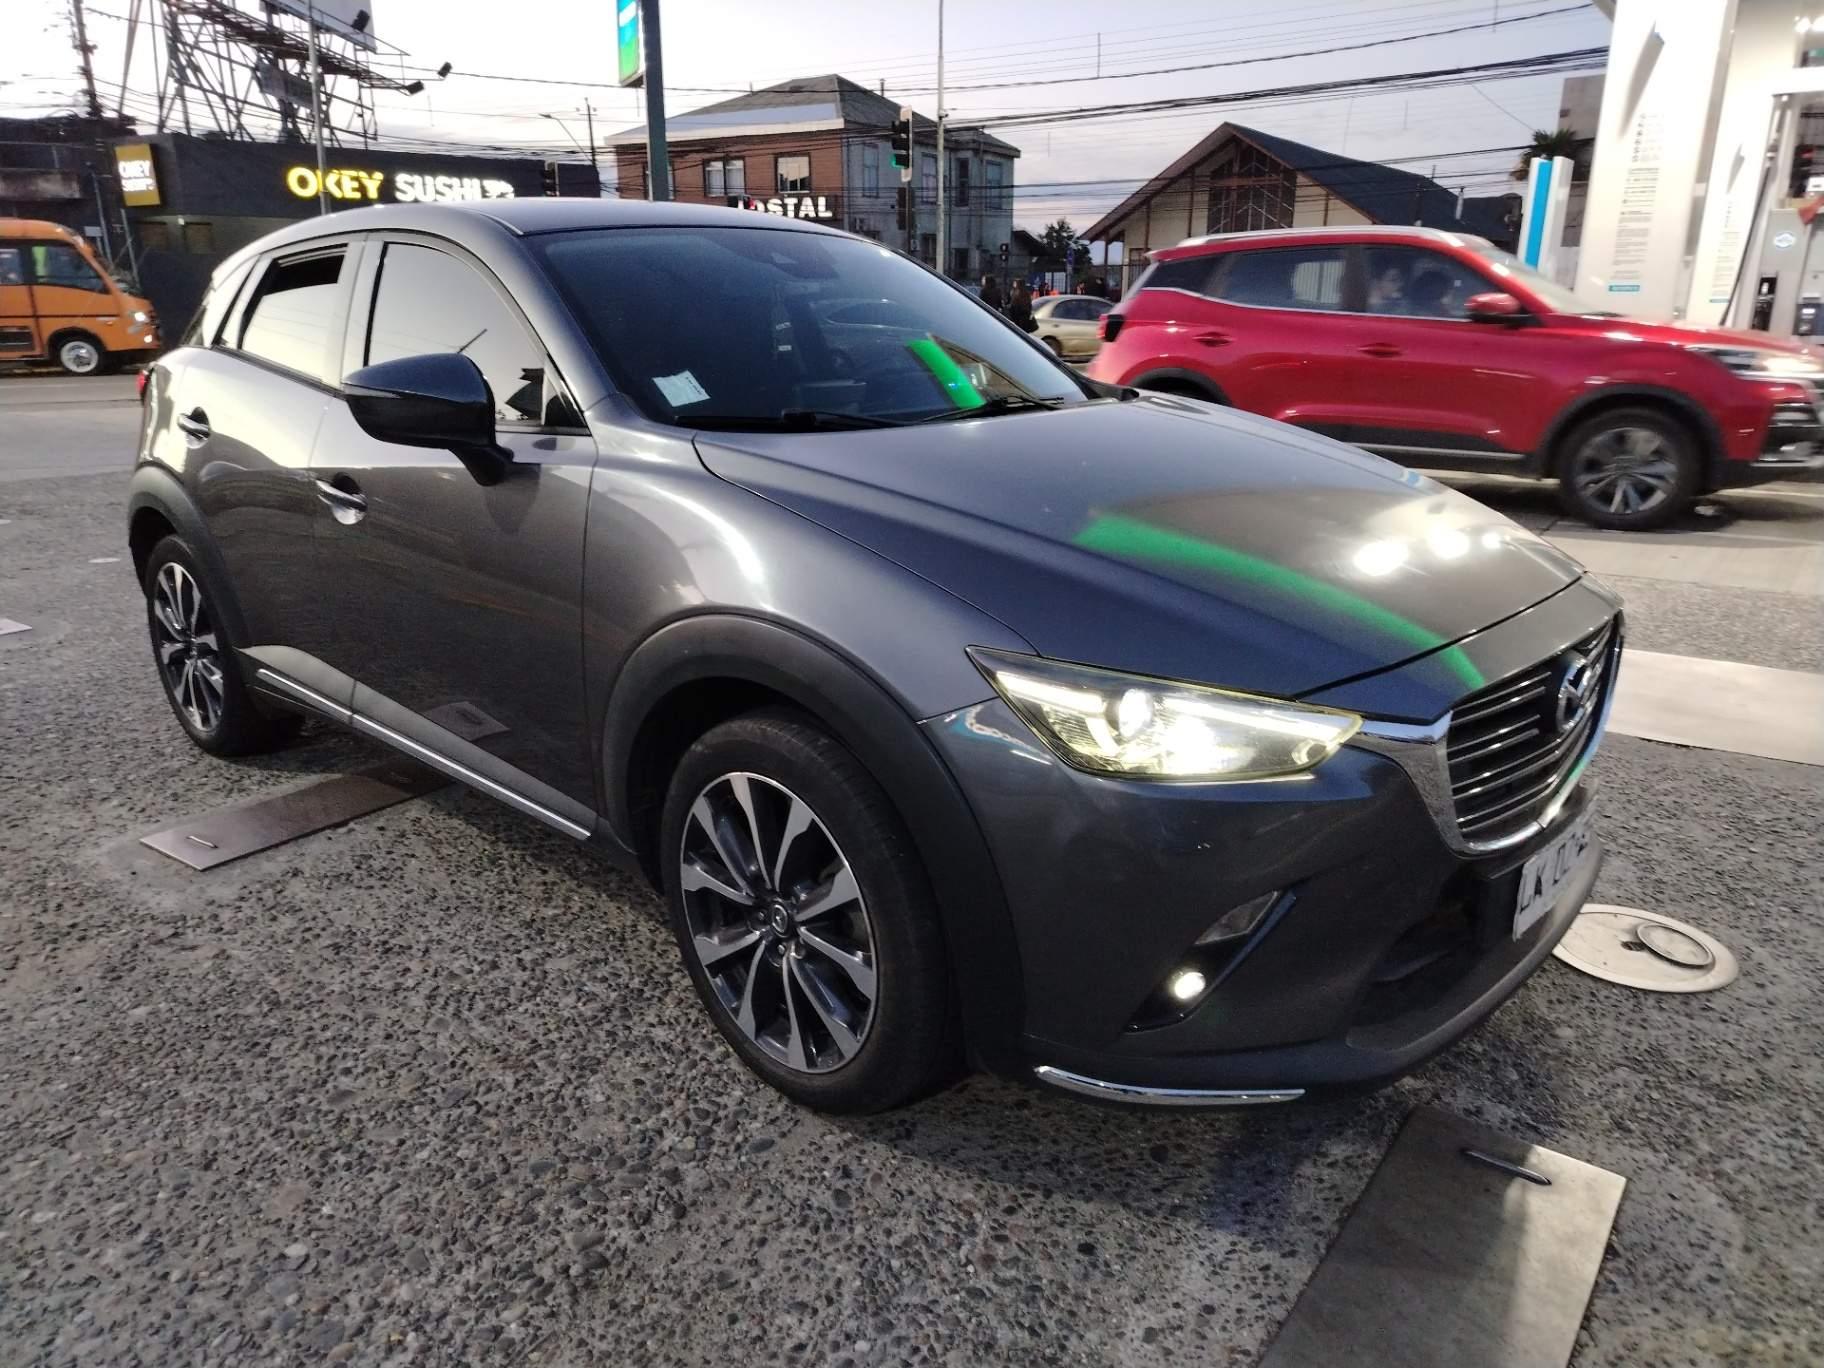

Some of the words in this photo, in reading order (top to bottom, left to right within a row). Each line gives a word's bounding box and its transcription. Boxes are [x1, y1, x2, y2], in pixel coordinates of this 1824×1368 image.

[287, 167, 383, 199] OKEY
[395, 173, 482, 201] SUSHI
[738, 196, 832, 218] STAL
